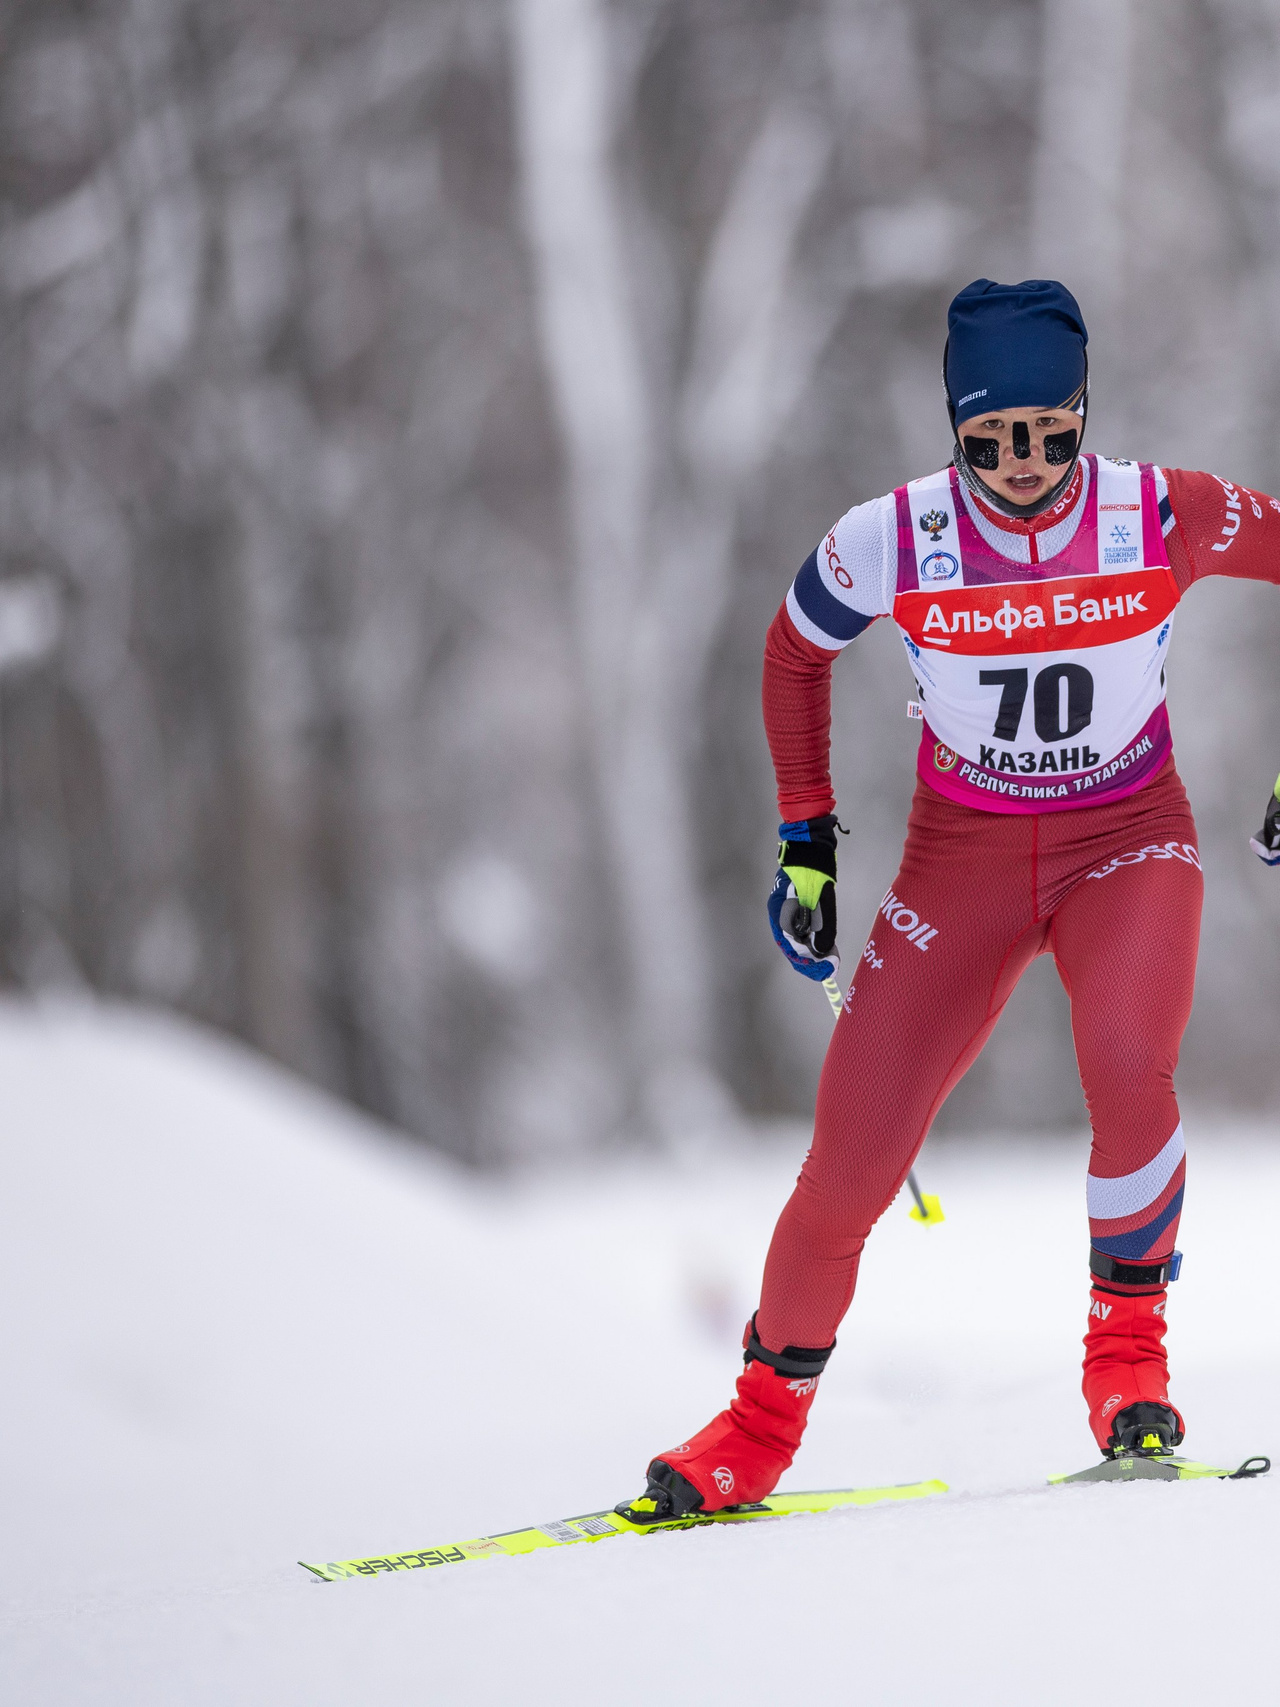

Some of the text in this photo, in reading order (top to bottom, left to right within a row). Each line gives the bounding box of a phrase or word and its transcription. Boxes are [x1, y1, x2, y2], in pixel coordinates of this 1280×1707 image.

[825, 520, 853, 589] SCO
[922, 591, 1148, 639] Альфа Банк
[979, 662, 1094, 743] 70
[958, 735, 1154, 799] РЕСПУБЛИКА ТАТАРСТАН
[979, 743, 1101, 774] КАЗАНЬ
[1090, 1296, 1113, 1321] AY
[349, 1546, 466, 1575] FISCHER
